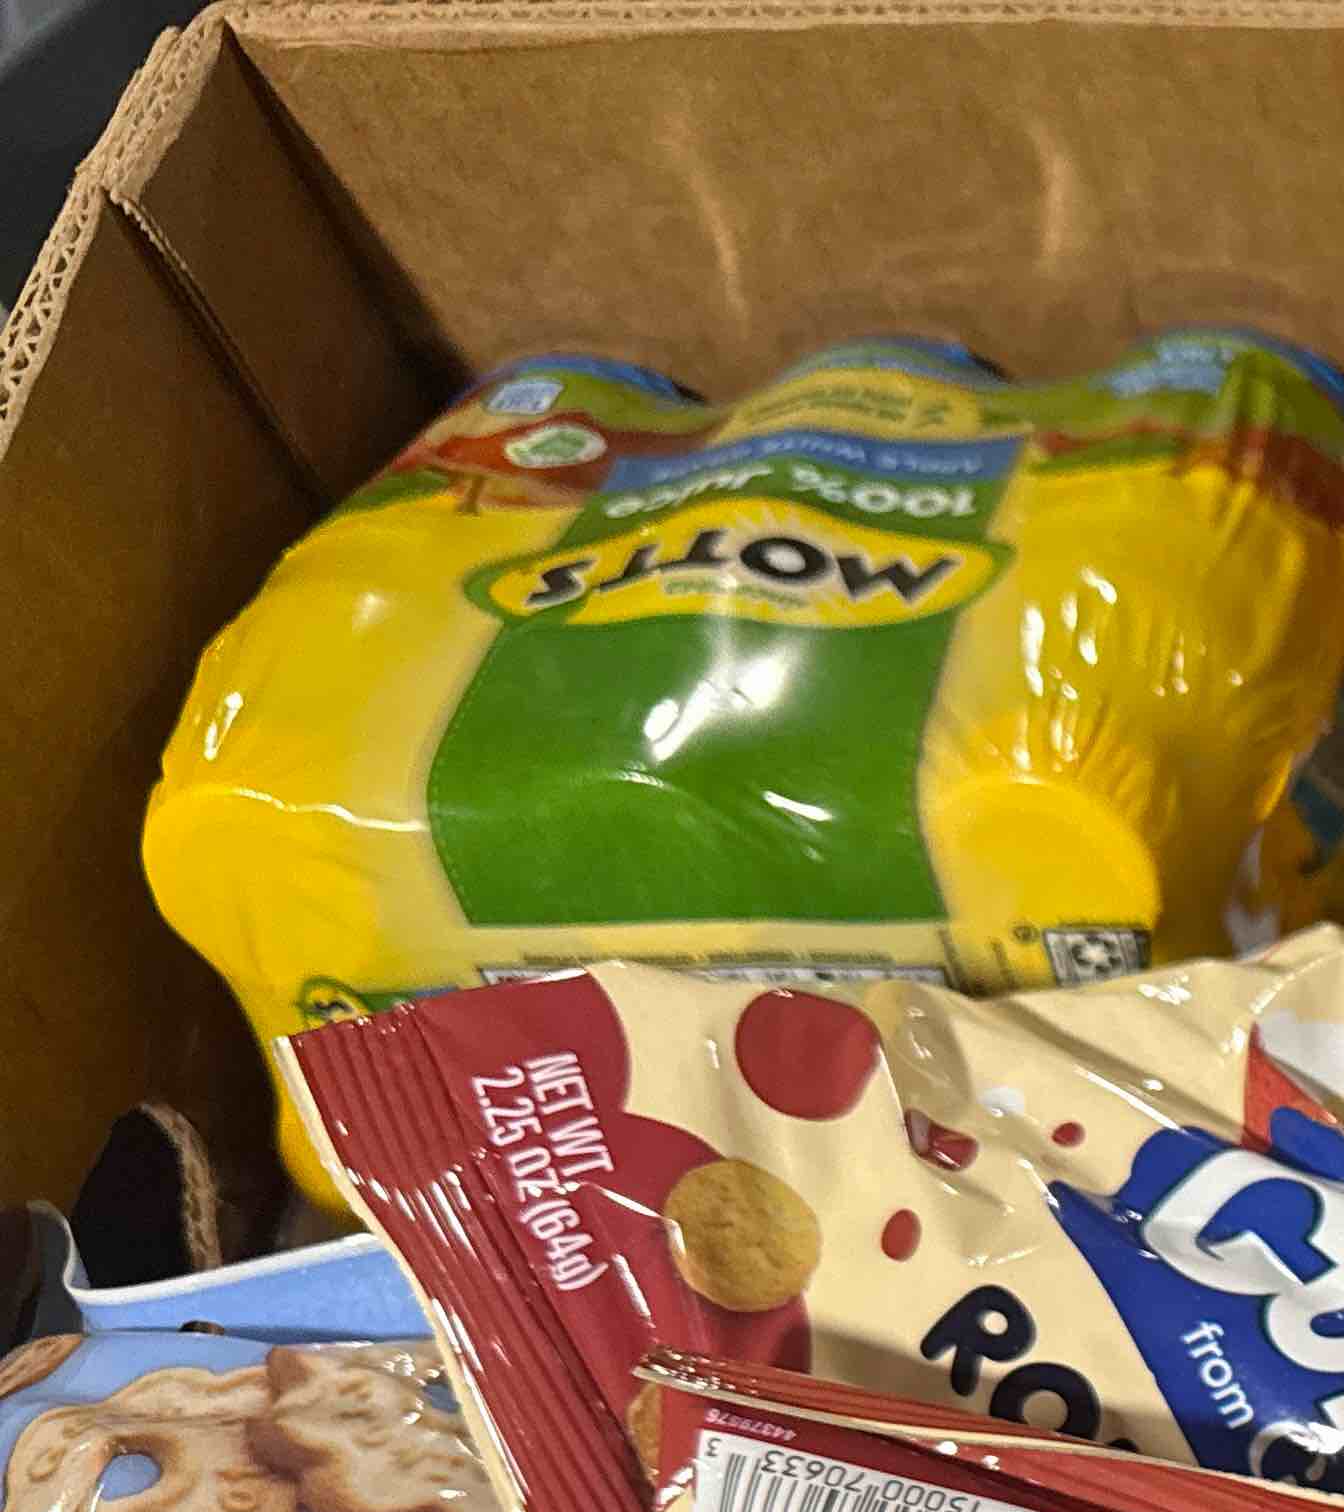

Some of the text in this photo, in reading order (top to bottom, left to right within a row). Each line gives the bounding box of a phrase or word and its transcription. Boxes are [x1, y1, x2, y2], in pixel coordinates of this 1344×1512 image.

[792, 464, 976, 518] 100%
[524, 1052, 614, 1176] NET WT
[472, 1064, 612, 1292] 2.25 OZ (64g)
[1179, 1318, 1252, 1432] from
[760, 1448, 869, 1494] 70633
